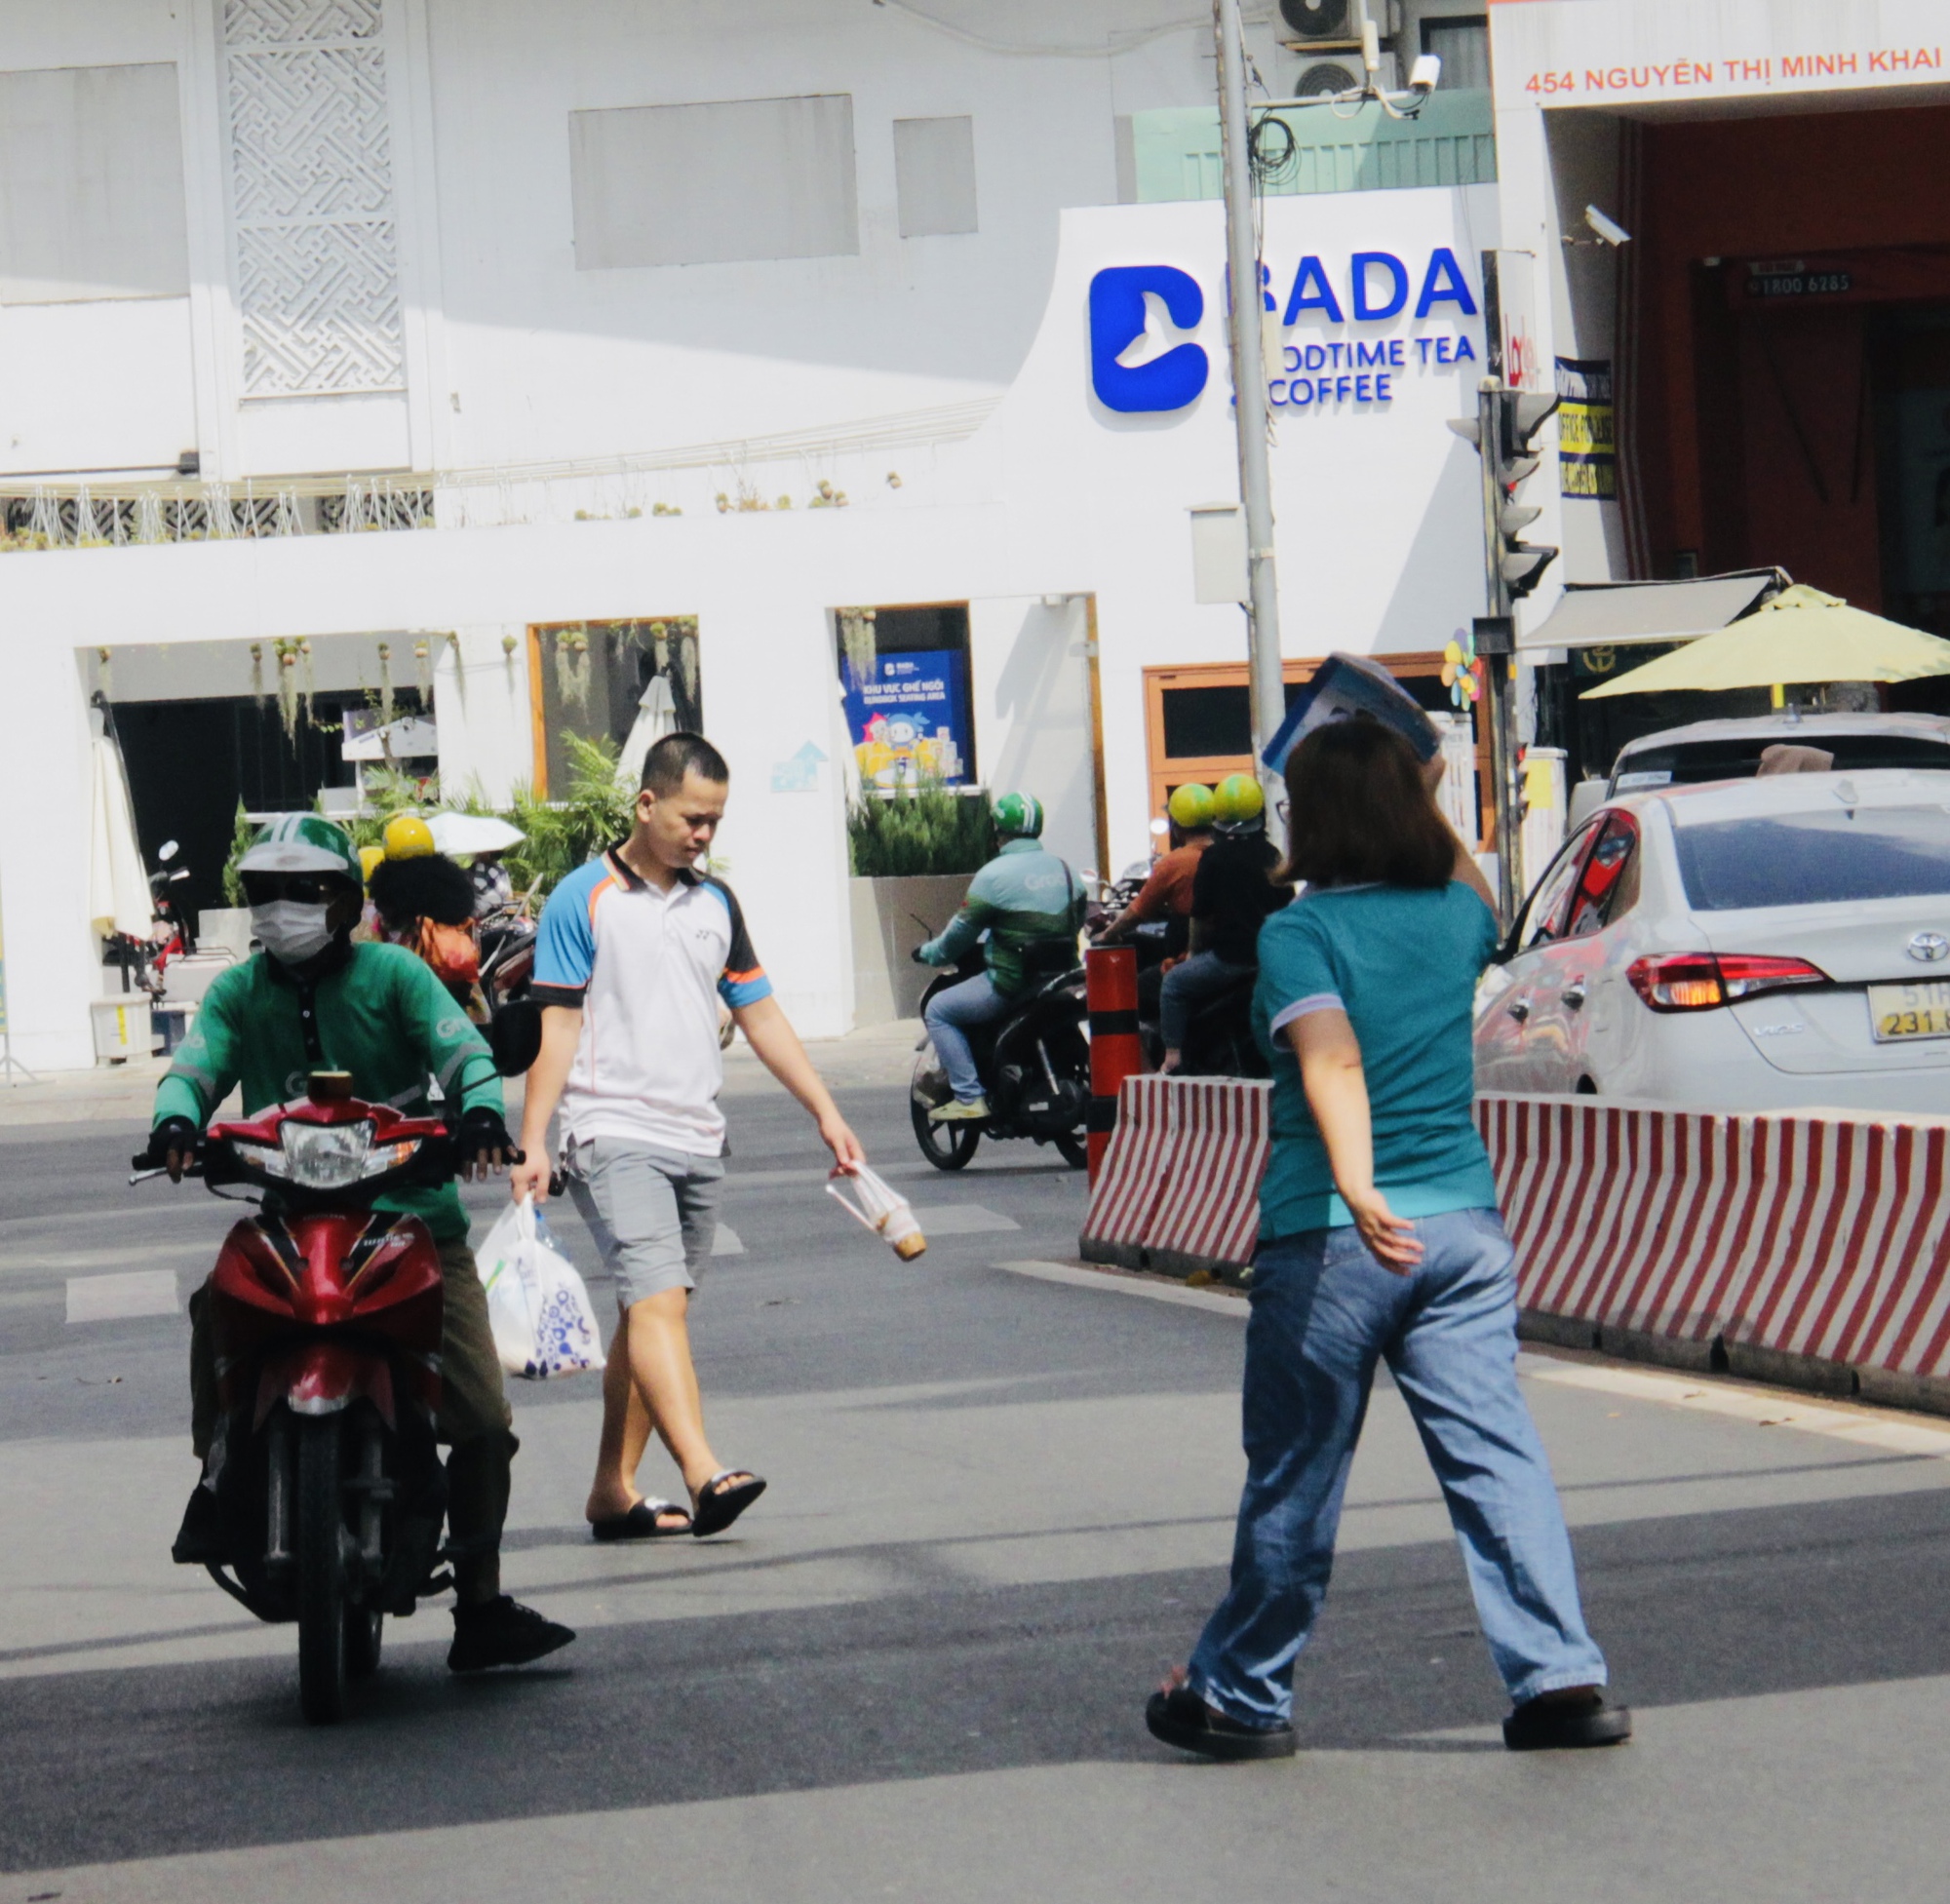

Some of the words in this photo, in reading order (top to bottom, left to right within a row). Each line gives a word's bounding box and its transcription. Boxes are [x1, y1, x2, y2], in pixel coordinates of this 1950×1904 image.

[1525, 70, 1575, 94] 454
[1585, 58, 1713, 91] NGUYỄN
[1723, 58, 1771, 85] THỊ
[1781, 53, 1857, 78] MINH
[1868, 47, 1941, 72] KHAI
[1763, 278, 1803, 294] 1800
[1284, 339, 1405, 372] ODTIME
[1416, 335, 1477, 365] TEA
[1268, 373, 1393, 407] COFFEE
